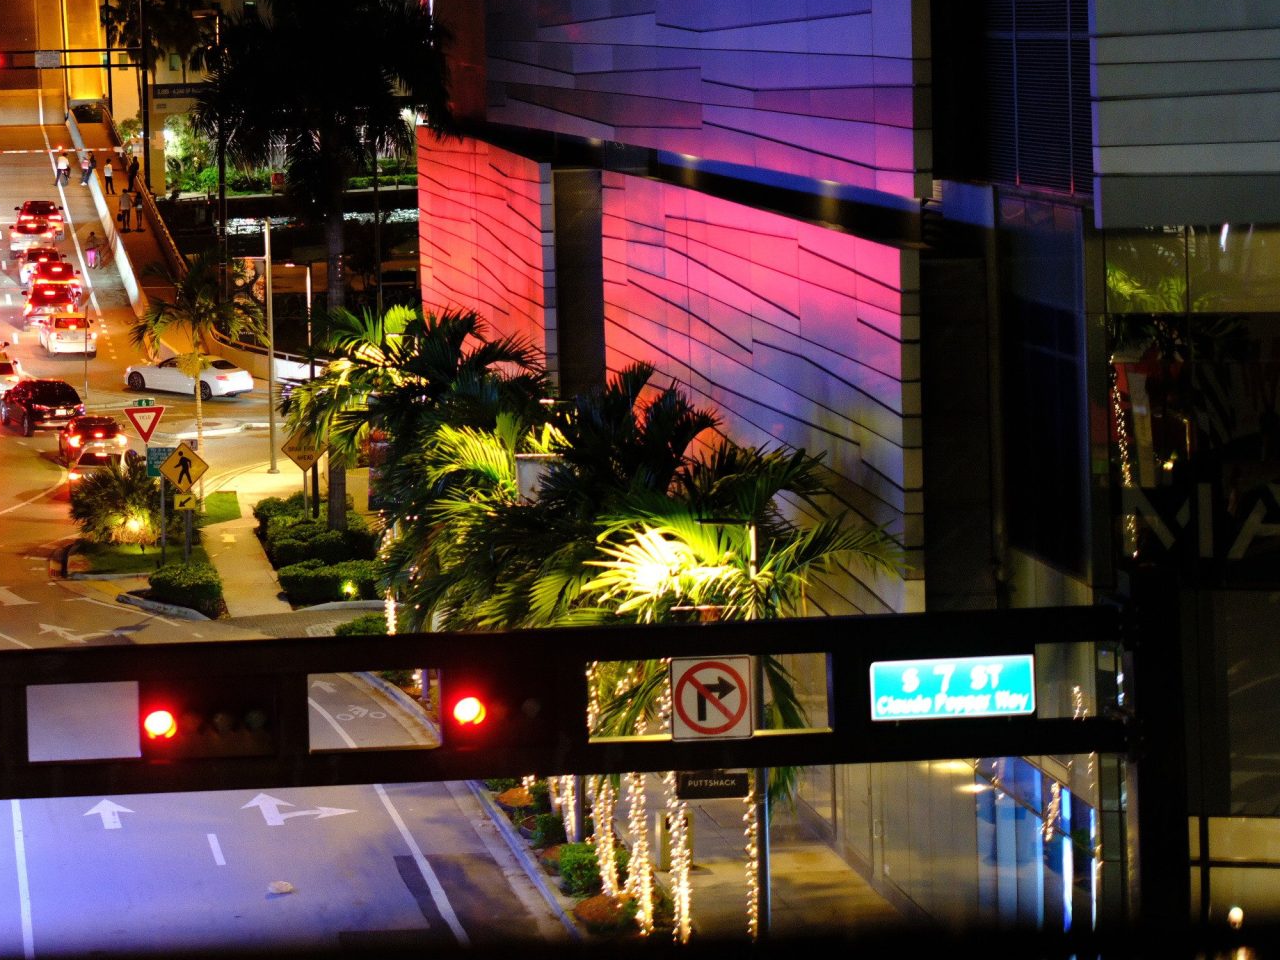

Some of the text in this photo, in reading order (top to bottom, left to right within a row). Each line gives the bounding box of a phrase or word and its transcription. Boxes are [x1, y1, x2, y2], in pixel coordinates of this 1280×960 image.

[901, 663, 1004, 694] S 7 ST
[994, 690, 1030, 711] Way
[687, 779, 737, 788] PUTTSHACK
